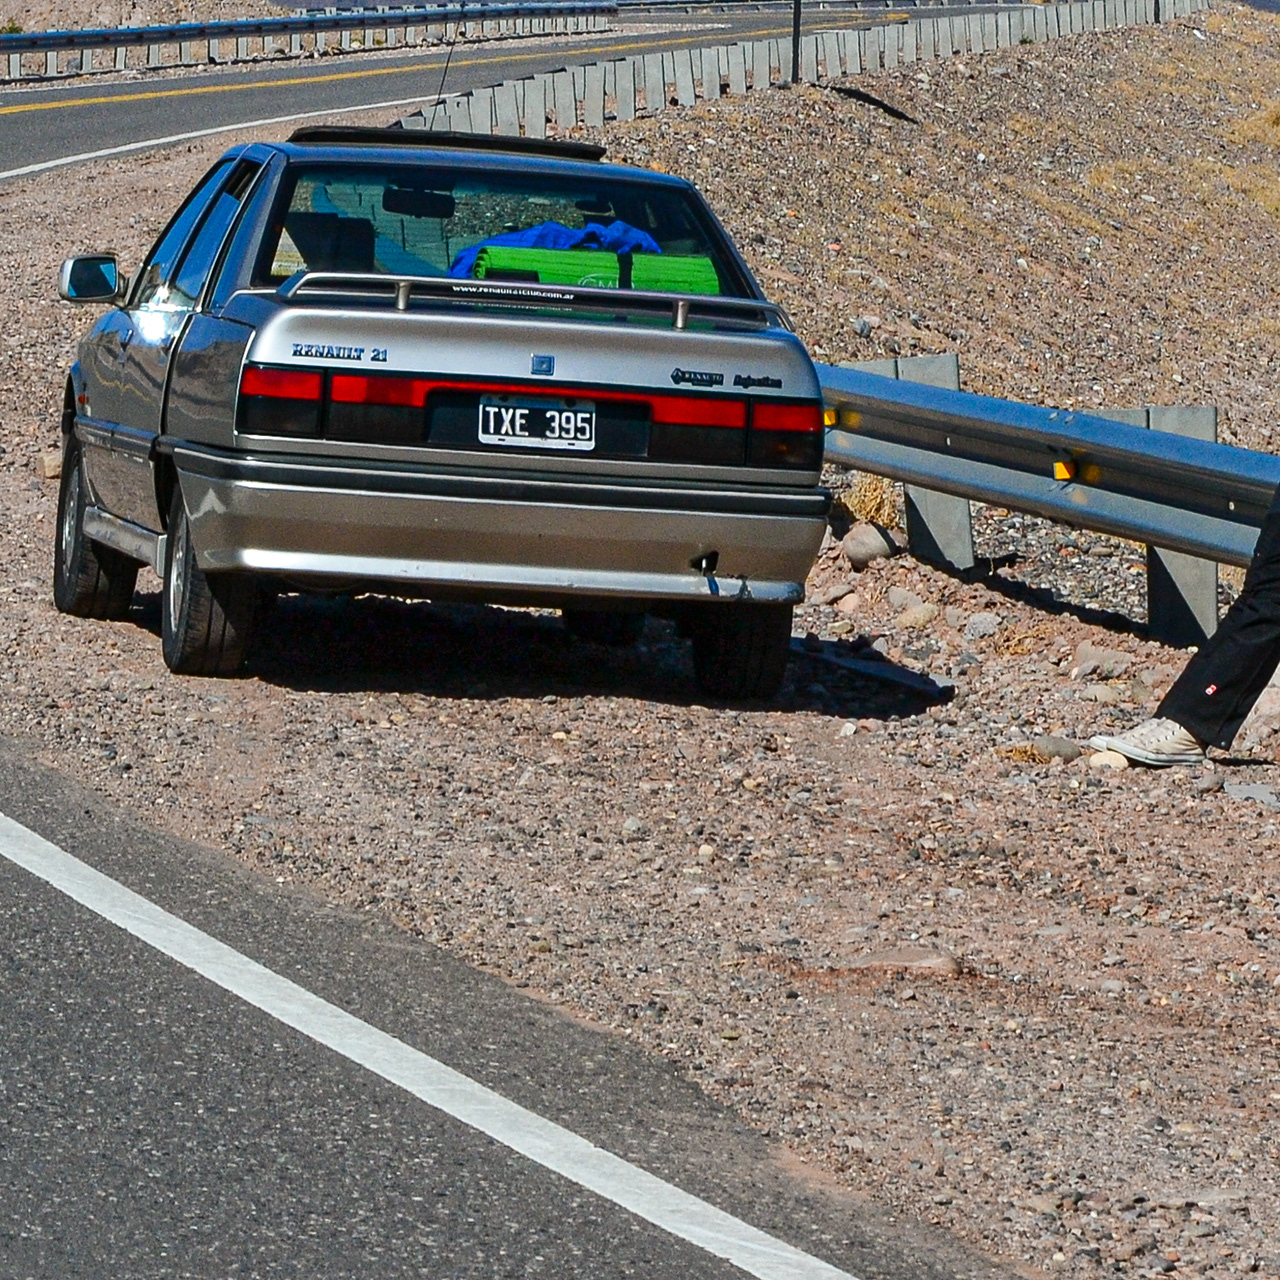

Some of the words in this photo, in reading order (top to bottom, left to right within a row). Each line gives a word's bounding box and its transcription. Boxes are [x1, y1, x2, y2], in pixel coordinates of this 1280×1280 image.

[292, 343, 365, 361] RENAULT
[370, 347, 388, 362] 21
[485, 406, 529, 436] TXE
[545, 410, 591, 440] 395
